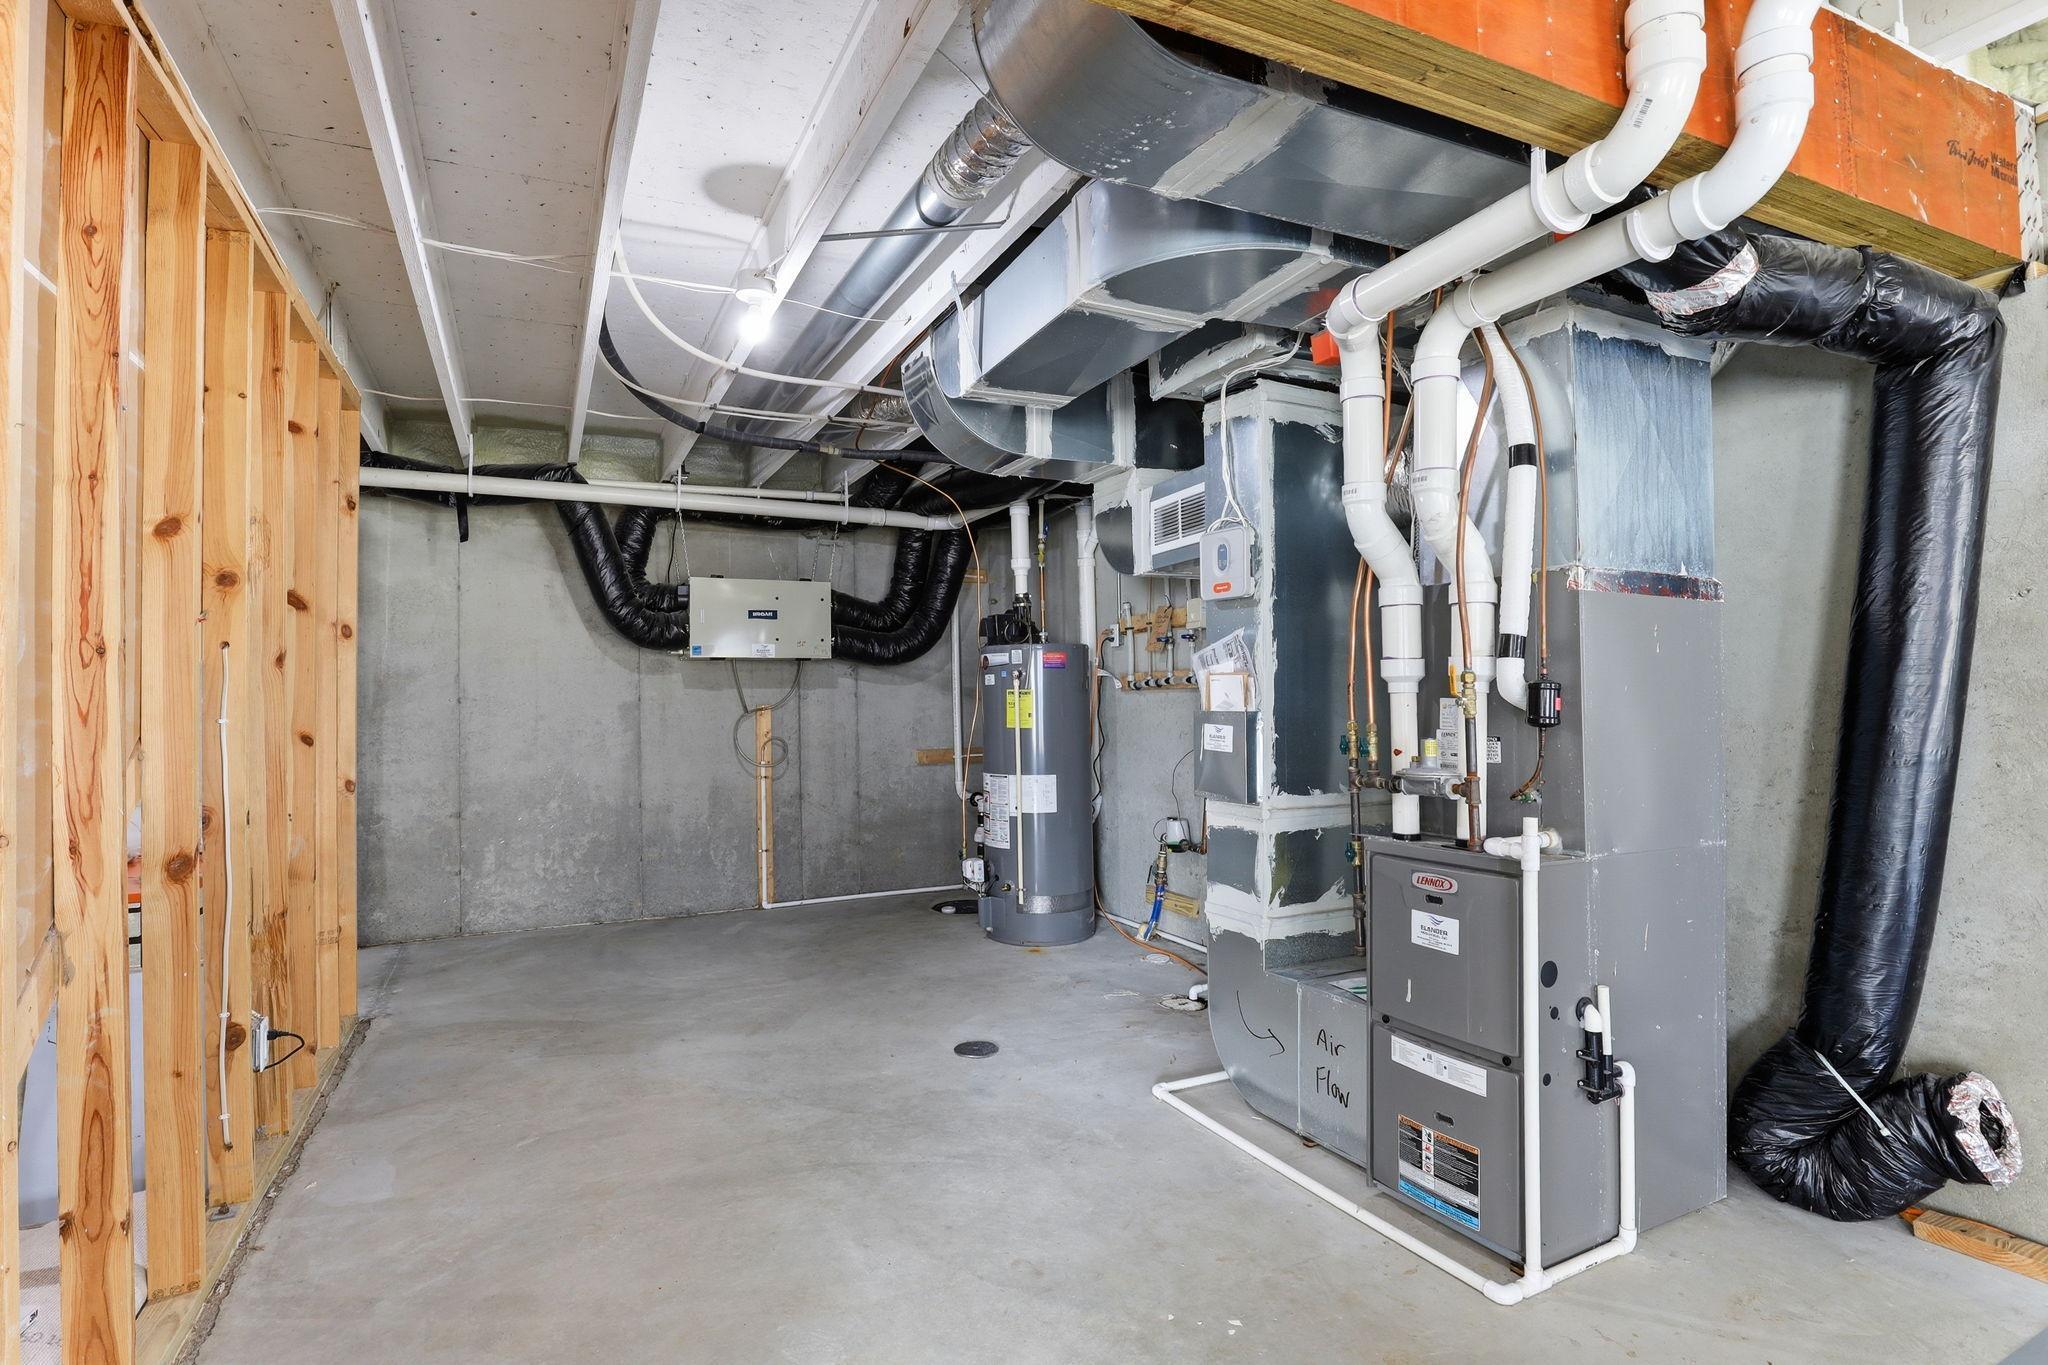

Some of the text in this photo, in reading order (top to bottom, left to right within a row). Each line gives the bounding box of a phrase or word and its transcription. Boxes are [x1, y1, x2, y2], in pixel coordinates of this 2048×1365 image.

[1416, 875, 1446, 889] LENNOX
[1316, 1028, 1346, 1056] Air
[1315, 1066, 1350, 1108] Flow
